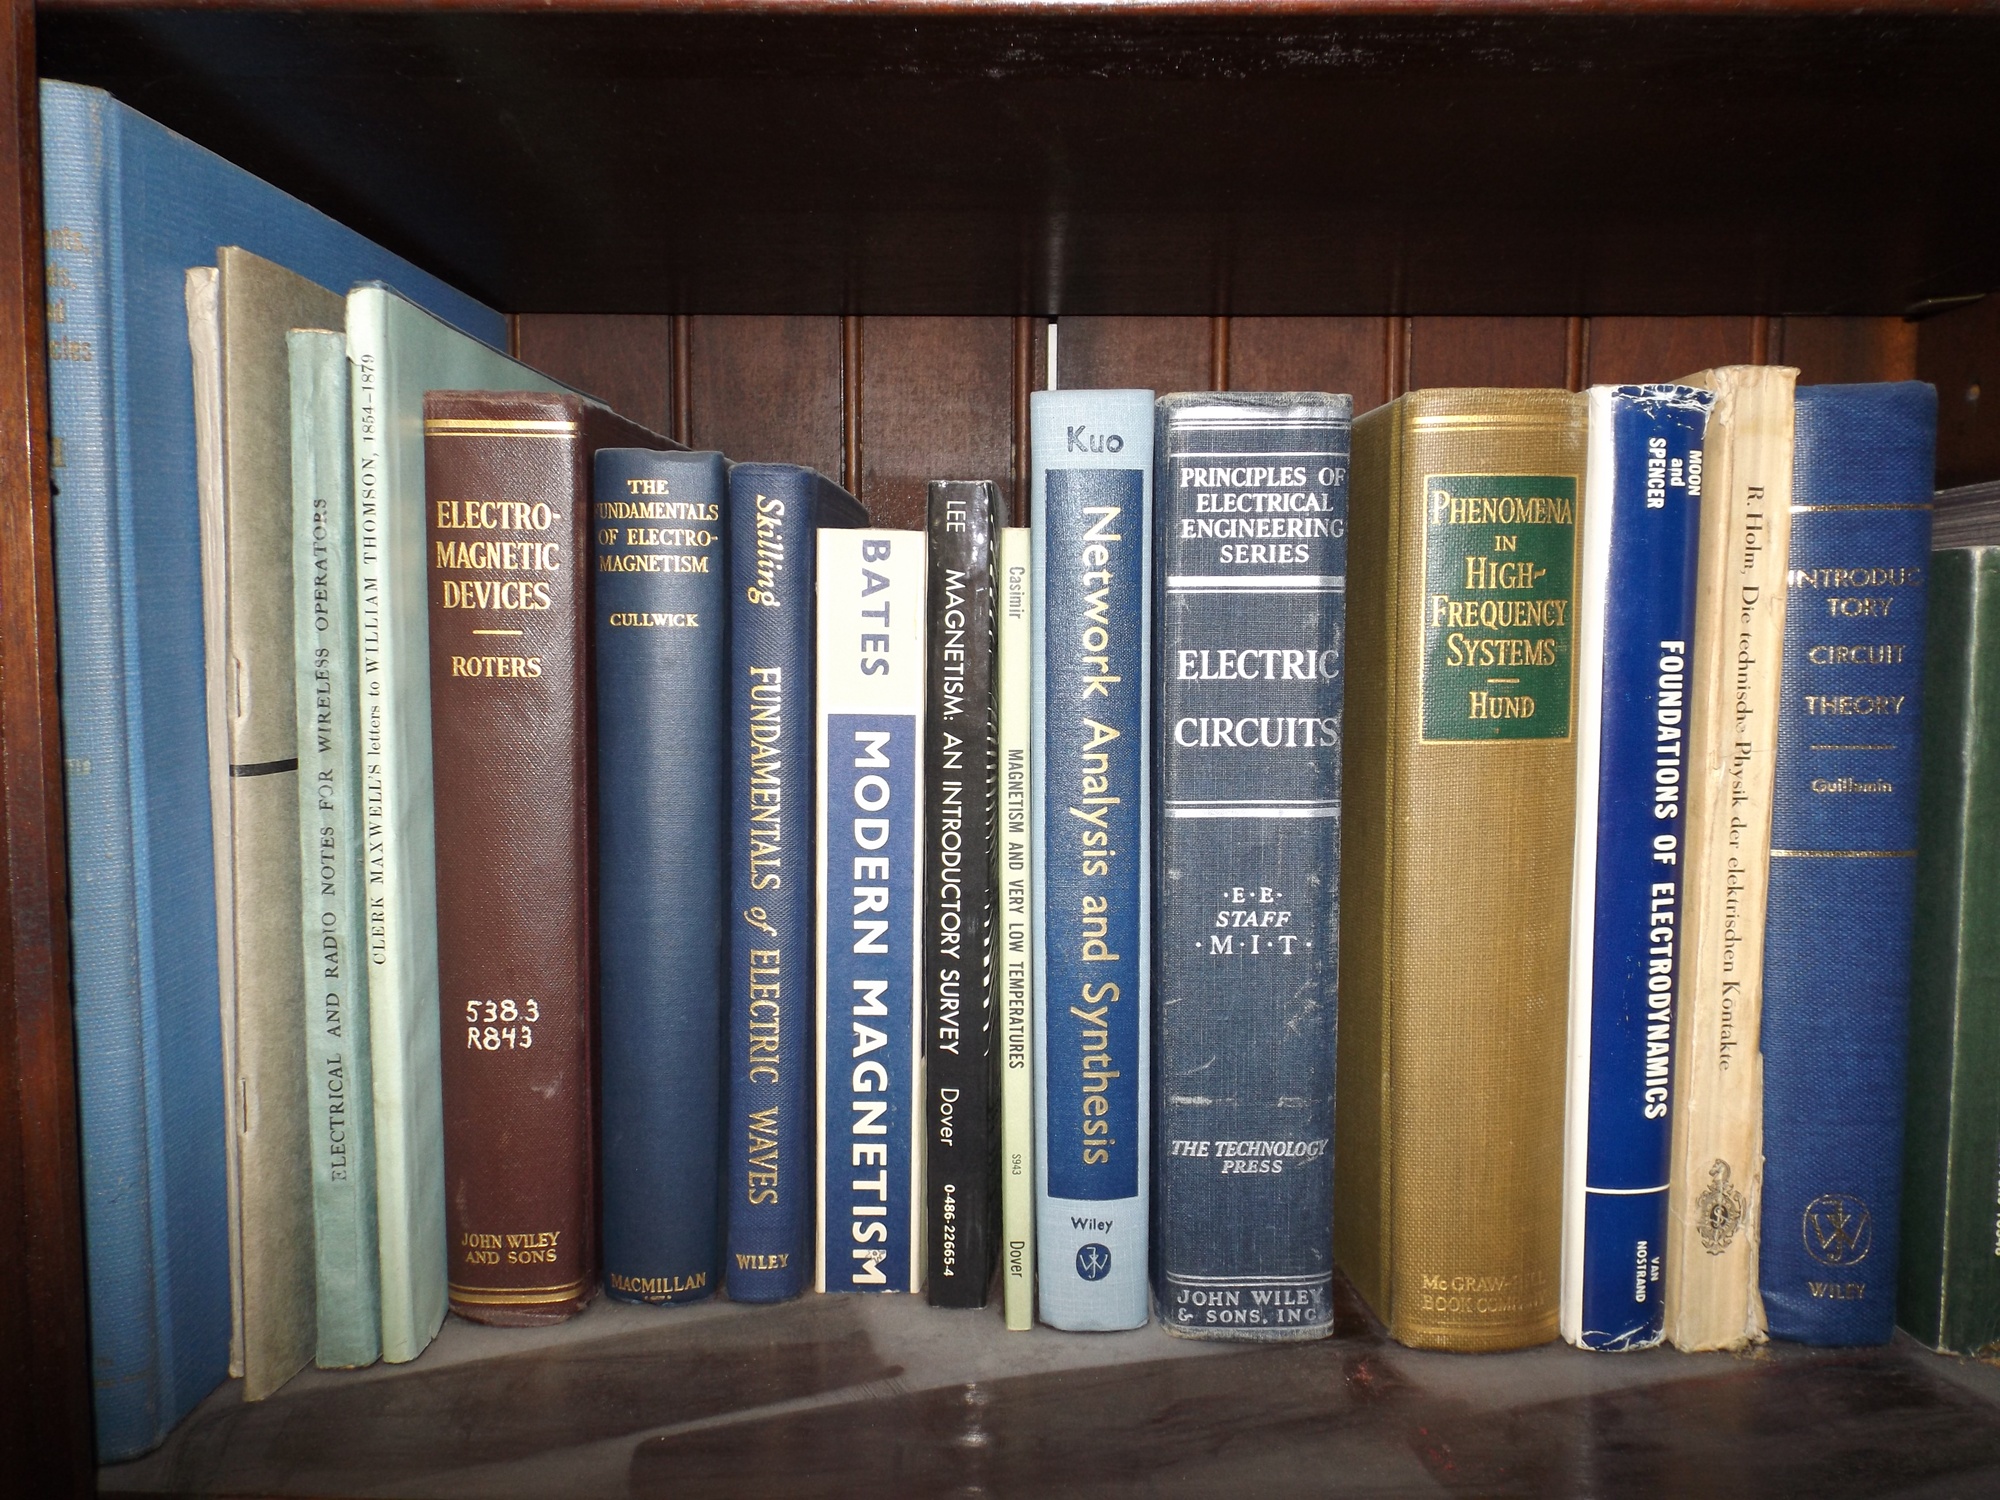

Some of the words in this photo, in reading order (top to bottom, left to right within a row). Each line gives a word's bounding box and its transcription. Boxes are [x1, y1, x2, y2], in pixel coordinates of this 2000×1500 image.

[1067, 425, 1124, 454] Kuo
[627, 479, 669, 495] THE
[1180, 467, 1306, 487] PRINCIPLES
[1318, 467, 1346, 487] OF
[1647, 437, 1667, 509] SPENCER
[1671, 458, 1686, 487] and
[1688, 450, 1702, 496] MOON
[362, 452, 379, 564] THOMSON,
[597, 502, 719, 521] UNDAMENTALS
[1196, 493, 1333, 513] ELECTRICAL
[1432, 490, 1573, 525] PHENOMENA
[1746, 485, 1765, 506] R.
[436, 501, 561, 530] ELECTRO-
[946, 500, 966, 533] LEE
[1181, 518, 1345, 539] ENGINEERING
[598, 529, 619, 545] OF
[627, 528, 718, 546] ELECTRO-
[747, 494, 786, 608] Skilling
[1494, 535, 1518, 552] IN
[1740, 513, 1763, 575] Holm,
[313, 498, 329, 632] OPERATORS
[436, 541, 561, 571] MAGNETIC
[599, 554, 709, 573] MAGNETISM
[1219, 545, 1310, 564] SERIES
[443, 580, 551, 610] DEVICES
[860, 539, 891, 677] BATES
[1008, 566, 1025, 620] Casimir
[1082, 506, 1122, 700] Network
[1740, 585, 1760, 625] Die
[1826, 597, 1893, 617] TORY
[363, 577, 380, 675] WILLIAM
[609, 613, 699, 627] CULLWICK
[1431, 594, 1569, 630] FREQUENCY
[943, 568, 966, 721] MAGNETISM:
[1446, 633, 1556, 667] SYSTEMS
[1808, 645, 1906, 665] CIRCUIT
[452, 656, 543, 678] ROTERS
[1177, 650, 1340, 680] ELECTRIC
[368, 681, 381, 697] to
[1735, 632, 1755, 733] technische
[315, 648, 332, 753] WIRELESS
[1469, 691, 1535, 719] HUND
[1805, 695, 1905, 715] THEORY
[367, 705, 382, 756] letters
[1175, 717, 1340, 748] CIRCUITS
[1654, 641, 1685, 819] FOUNDATIONS
[942, 731, 963, 770] AN
[318, 768, 334, 811] FOR
[749, 666, 781, 890] FUNDAMENTALS
[1008, 749, 1024, 833] MAGNETISM
[1729, 741, 1752, 808] Physik
[1811, 778, 1892, 793] Guillemin
[1069, 717, 1121, 876] Analysis
[368, 763, 384, 885] MAXWELL'S
[1729, 815, 1747, 849] der
[853, 730, 891, 955] MODERN
[1008, 841, 1024, 871] AND
[1653, 834, 1677, 865] OF
[320, 826, 336, 896] NOTES
[940, 781, 962, 960] INTRODUCTORY
[1008, 879, 1024, 914] VERY
[371, 896, 386, 966] CLERK
[743, 907, 778, 937] of
[1082, 895, 1120, 961] and
[1215, 911, 1291, 927] STAFF
[1723, 856, 1745, 972] elektrischen
[322, 911, 339, 979] RADIO
[1008, 922, 1025, 953] LOW
[326, 992, 342, 1038] AND
[749, 948, 780, 1084] ELECTRIC
[939, 968, 961, 1055] SURVEY
[1008, 960, 1025, 1069] TEMPERATURES
[1644, 882, 1675, 1120] ELECTRODYNAMICS
[467, 1025, 533, 1051] R843
[1719, 980, 1741, 1072] Kontakte
[1070, 981, 1120, 1165] Synthesis
[328, 1052, 346, 1182] ELECTRICAL
[851, 979, 888, 1286] MAGNETISM
[939, 1088, 960, 1147] Dover
[748, 1106, 779, 1205] WAVES
[1011, 1153, 1022, 1176] S943
[1171, 1140, 1209, 1157] THE
[1215, 1139, 1328, 1157] TECHNOLOGY
[1222, 1160, 1283, 1174] PRESS
[461, 1232, 502, 1249] JOHN
[506, 1230, 561, 1249] WILEY
[943, 1183, 956, 1277] 0-486-22665-4
[1071, 1216, 1113, 1234] Wiley
[465, 1250, 500, 1265] AND
[507, 1248, 558, 1264] SONS
[735, 1253, 790, 1271] WILEY
[1010, 1240, 1025, 1278] Dover
[1635, 1240, 1648, 1303] NOSTRAND
[1650, 1256, 1660, 1282] VAN
[611, 1271, 707, 1293] MACMILLAN
[1177, 1289, 1240, 1306] JOHN
[1250, 1287, 1323, 1306] WILEY
[1808, 1281, 1866, 1300] WILEY
[1178, 1307, 1194, 1322] &
[1421, 1294, 1473, 1313] BOOK
